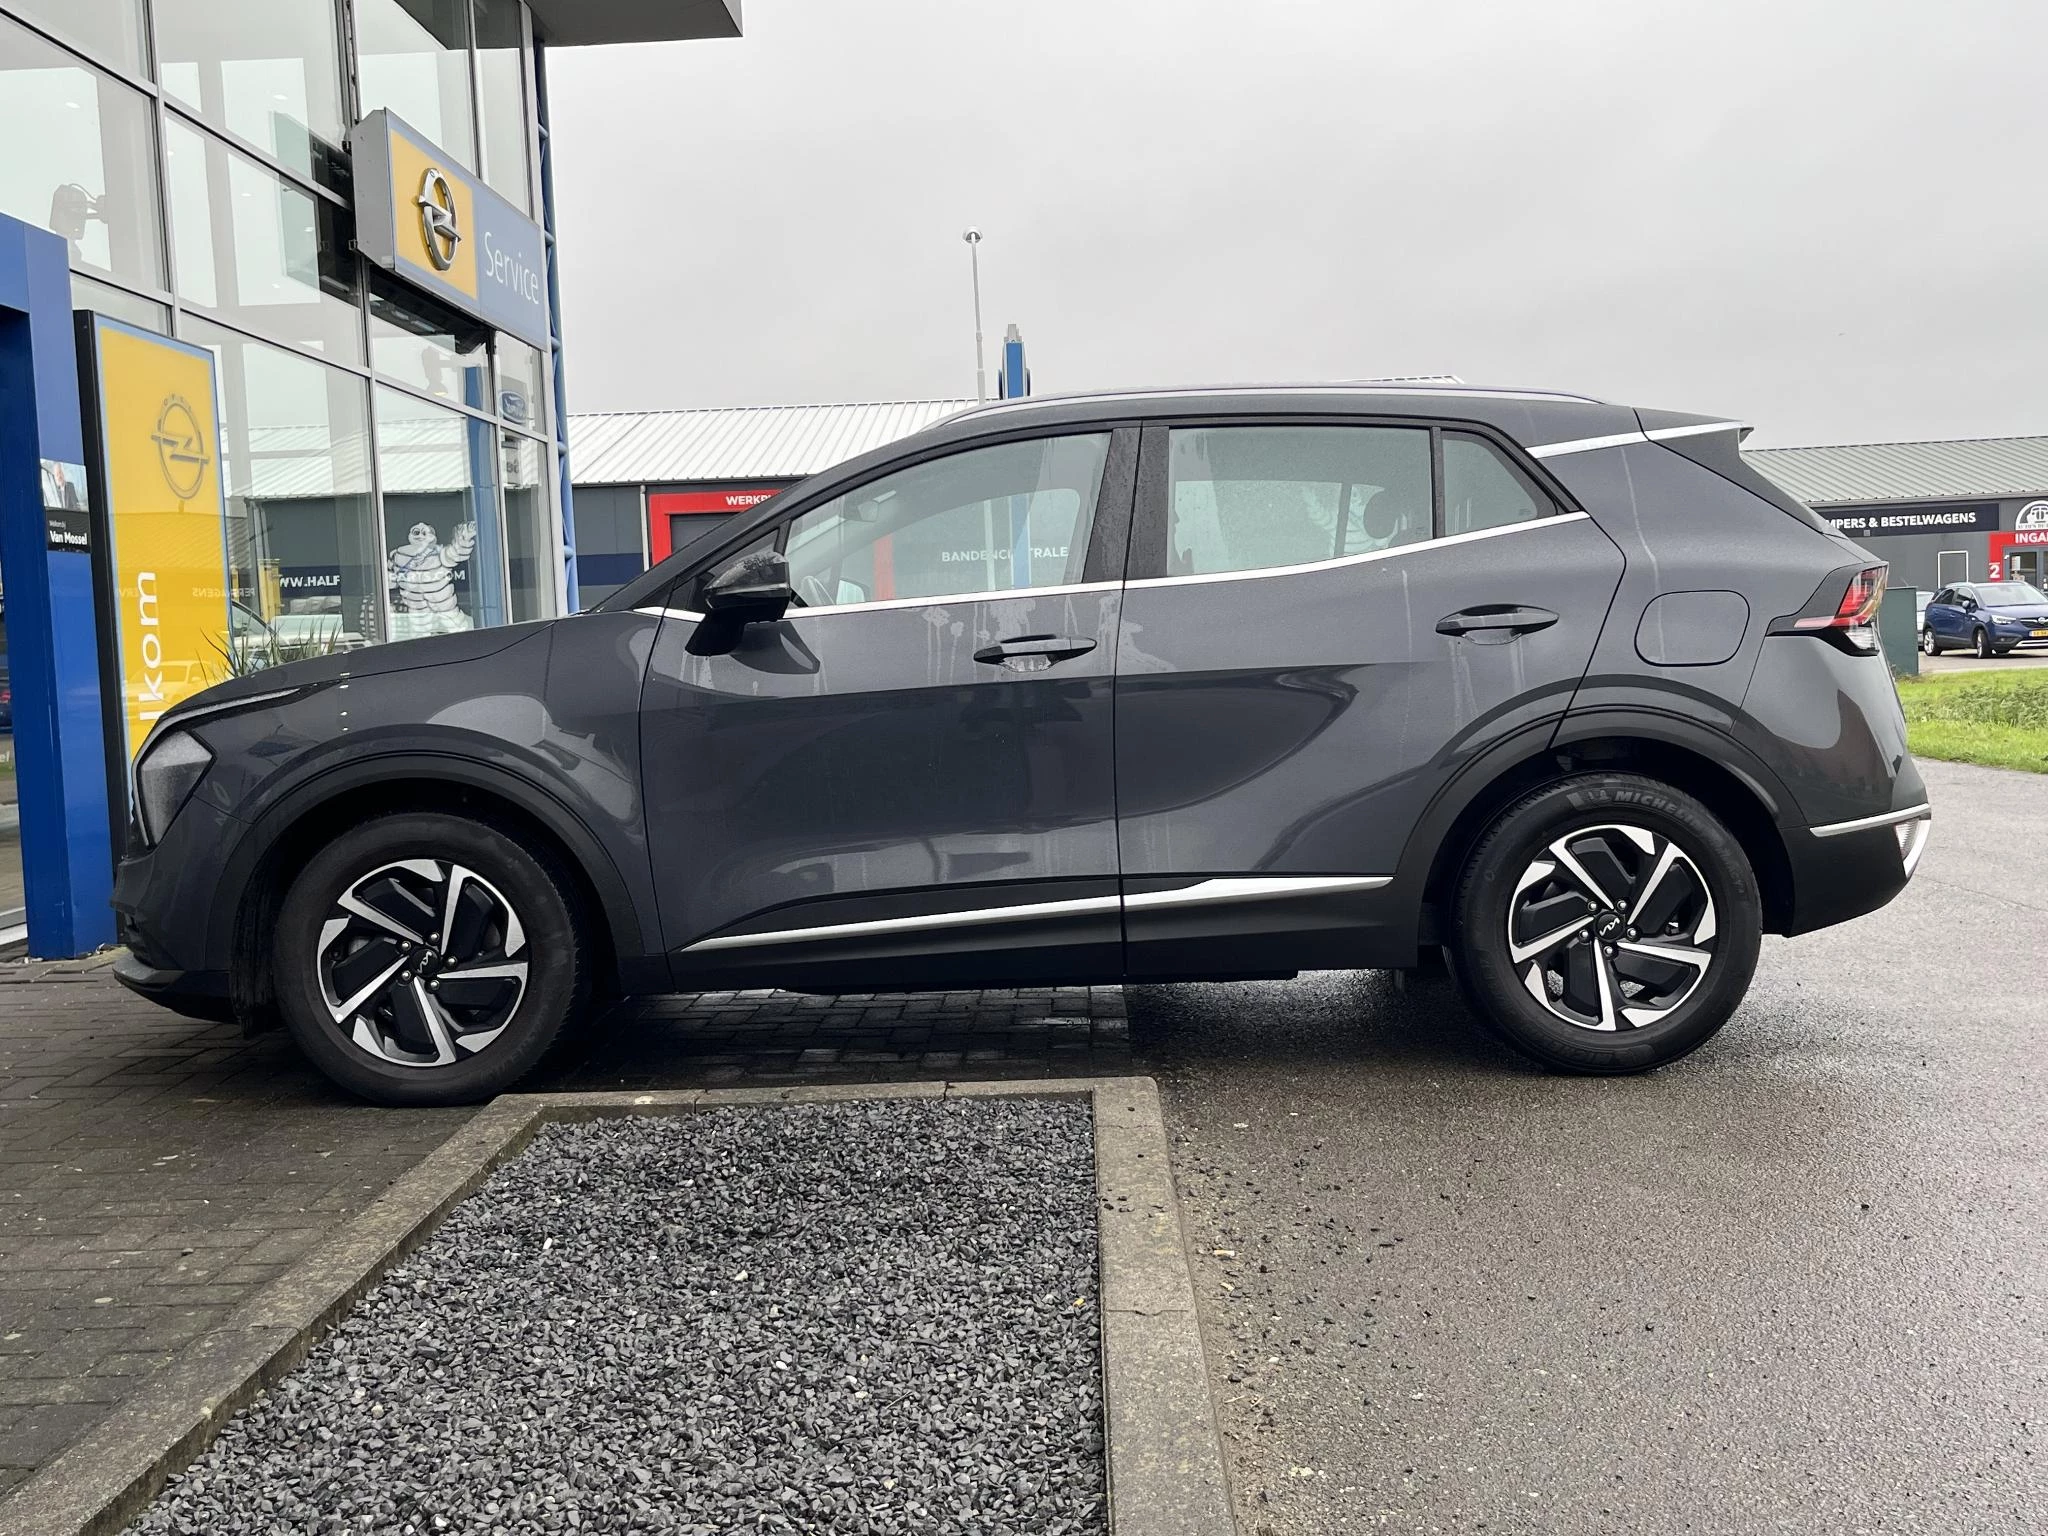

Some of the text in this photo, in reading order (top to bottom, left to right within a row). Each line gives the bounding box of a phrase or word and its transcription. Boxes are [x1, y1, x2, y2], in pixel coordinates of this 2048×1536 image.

[484, 230, 540, 305] Service
[726, 494, 771, 506] WERKP
[1868, 517, 1878, 528] &
[1881, 512, 1977, 527] BESTELWAGENS
[50, 530, 88, 545] Van Mossel
[1990, 564, 2001, 579] 2
